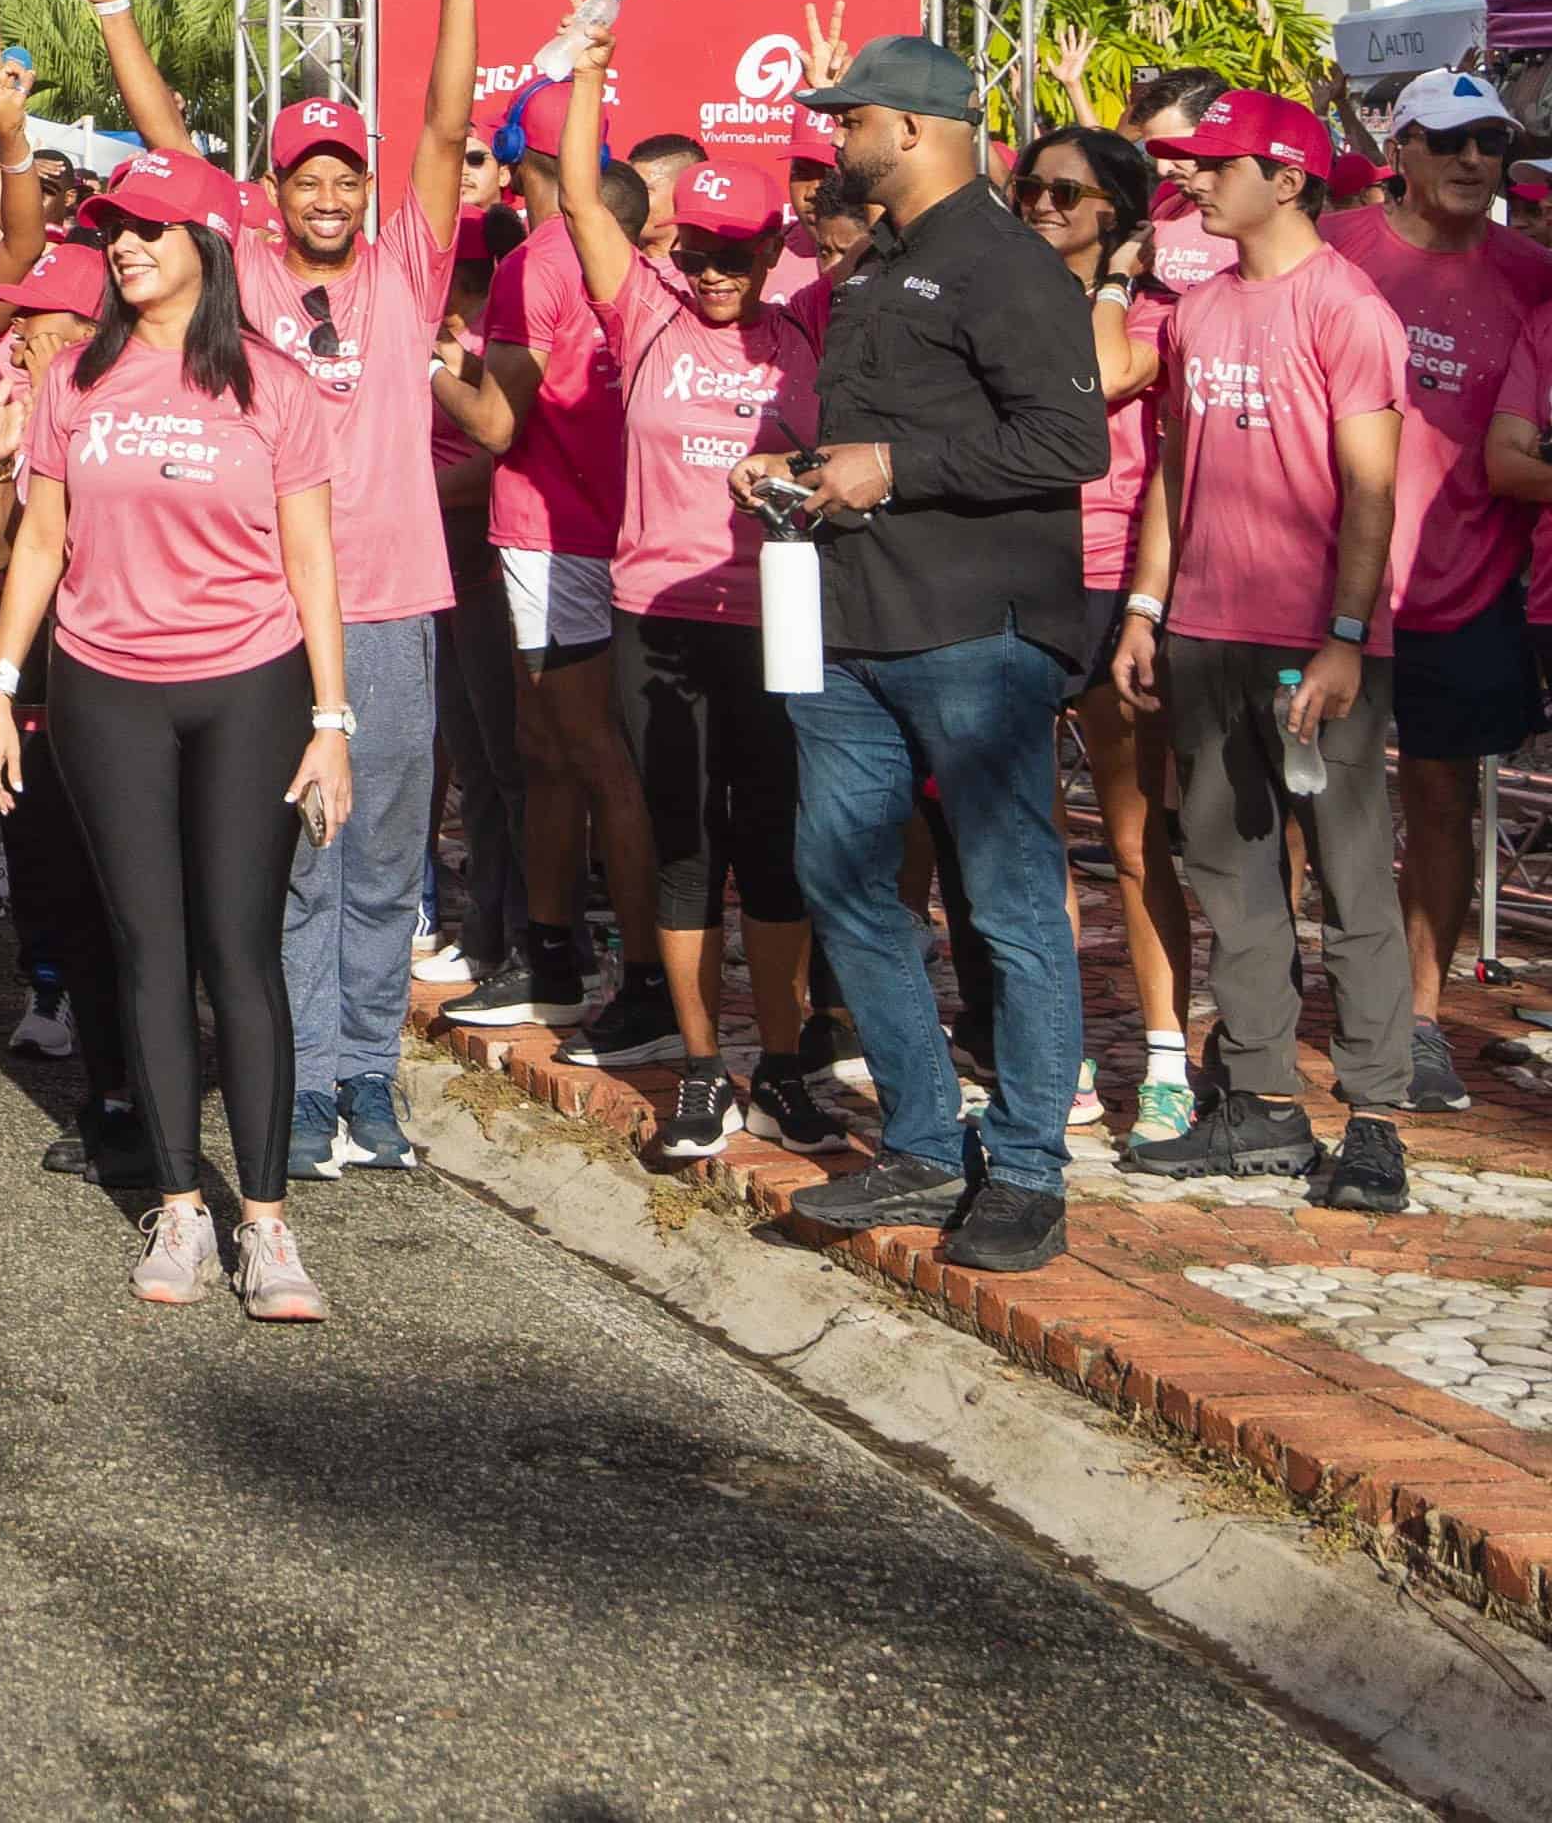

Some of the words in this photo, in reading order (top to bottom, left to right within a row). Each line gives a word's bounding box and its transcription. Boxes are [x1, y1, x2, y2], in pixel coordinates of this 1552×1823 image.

[1385, 32, 1424, 57] ALTIO
[302, 102, 338, 129] GC
[692, 169, 733, 201] GC
[1407, 325, 1456, 352] ntos
[1410, 353, 1469, 377] ecer
[114, 411, 206, 436] Juntos
[115, 435, 219, 464] Crecer
